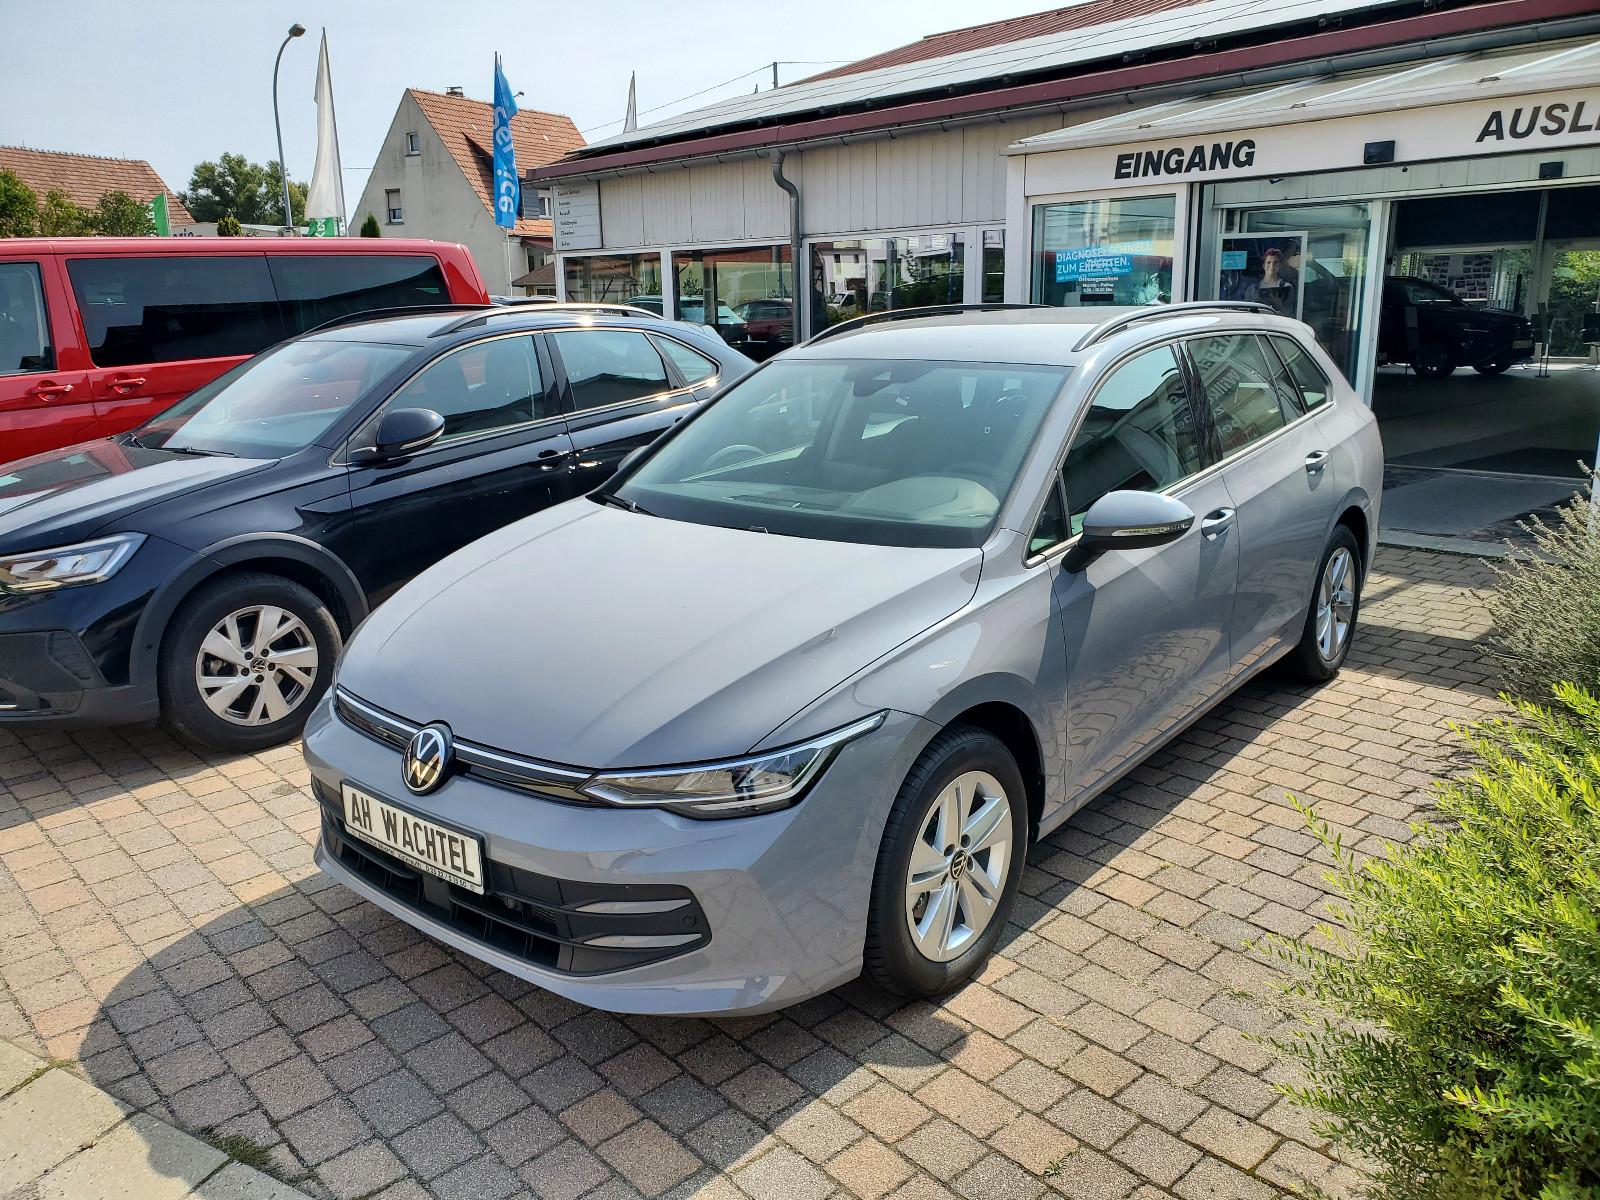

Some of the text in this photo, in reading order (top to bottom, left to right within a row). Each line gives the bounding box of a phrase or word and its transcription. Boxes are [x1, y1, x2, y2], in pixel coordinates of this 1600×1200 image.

[1115, 139, 1256, 180] EINGANG
[1108, 240, 1153, 256] SCHNELL
[1057, 263, 1077, 275] ZUM
[351, 792, 475, 878] AH WACHTEL
